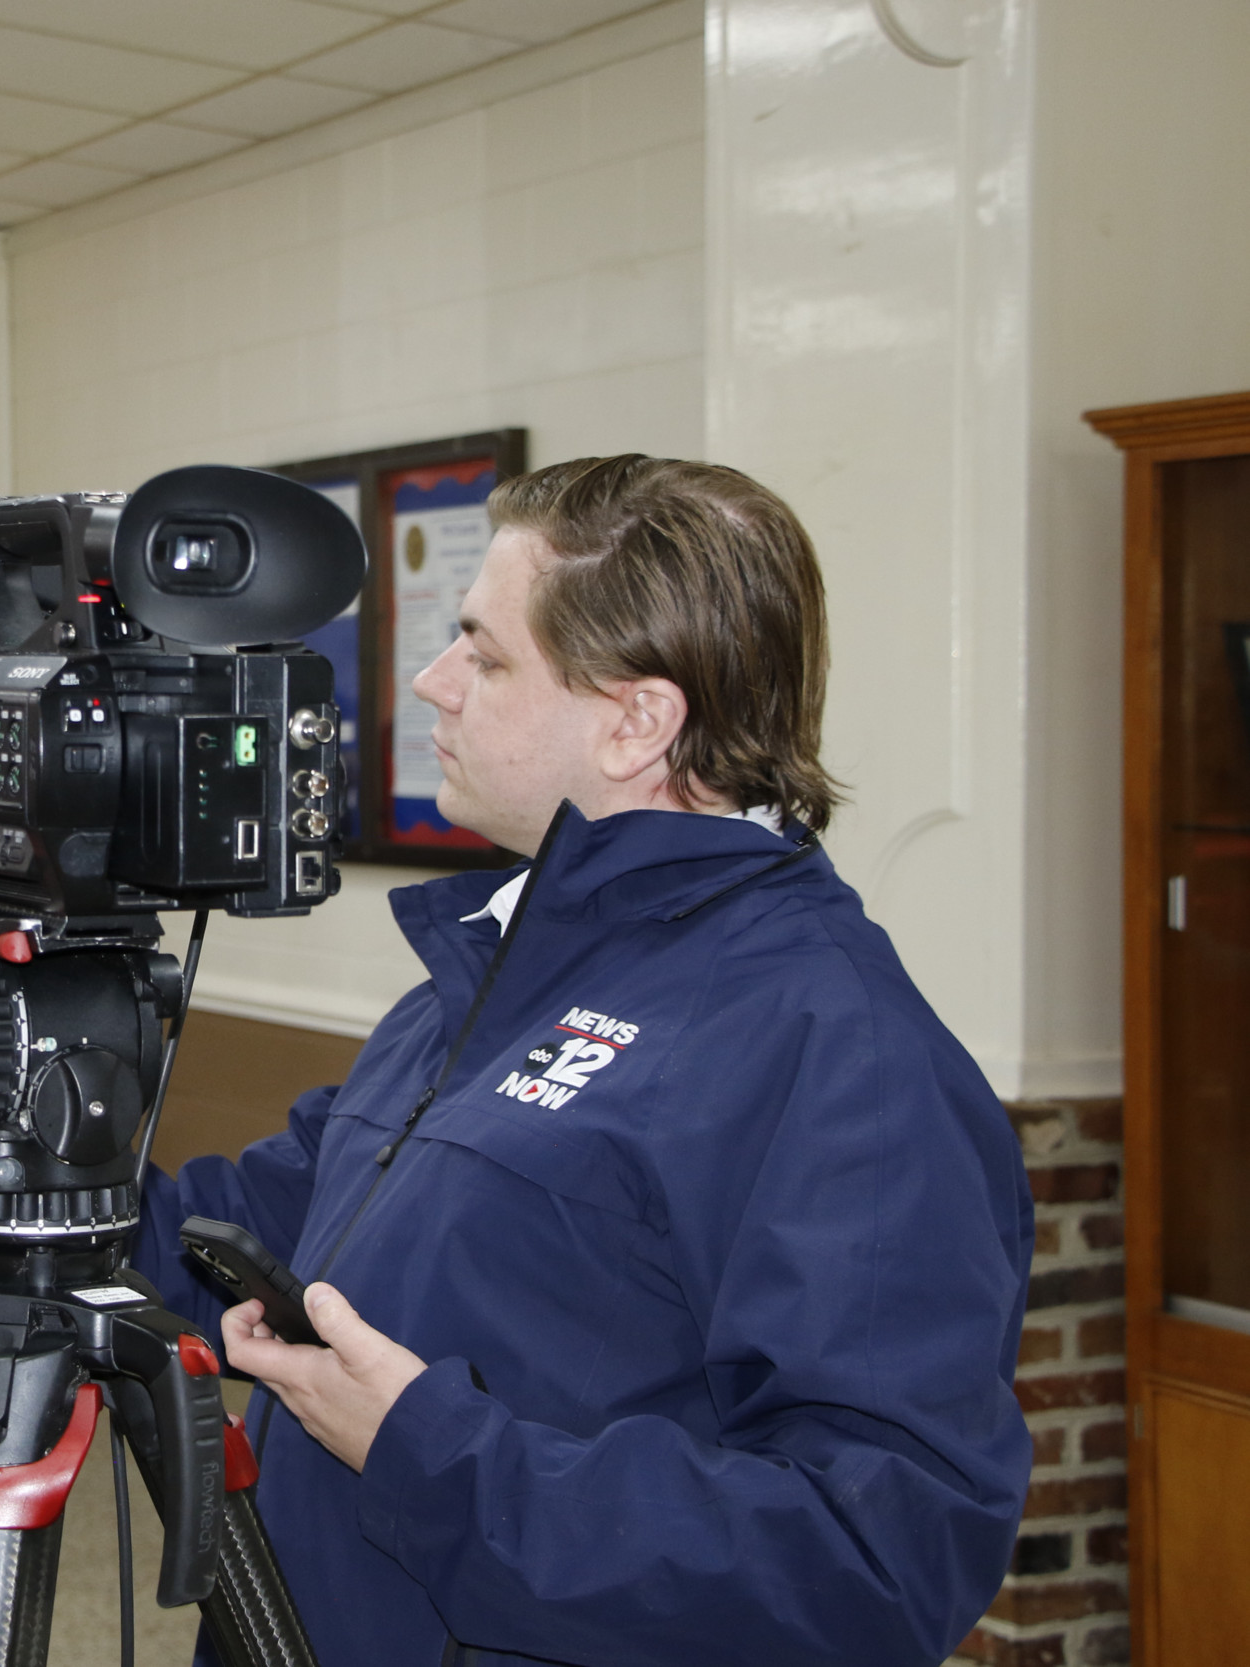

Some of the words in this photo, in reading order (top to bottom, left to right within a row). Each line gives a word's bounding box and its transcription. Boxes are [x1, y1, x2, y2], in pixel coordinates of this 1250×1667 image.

[7, 666, 50, 679] SONY
[559, 1006, 640, 1045] NEWS
[528, 1049, 553, 1063] abc
[542, 1037, 615, 1088] 12
[495, 1071, 578, 1110] NOW
[197, 1461, 220, 1553] flowtech
